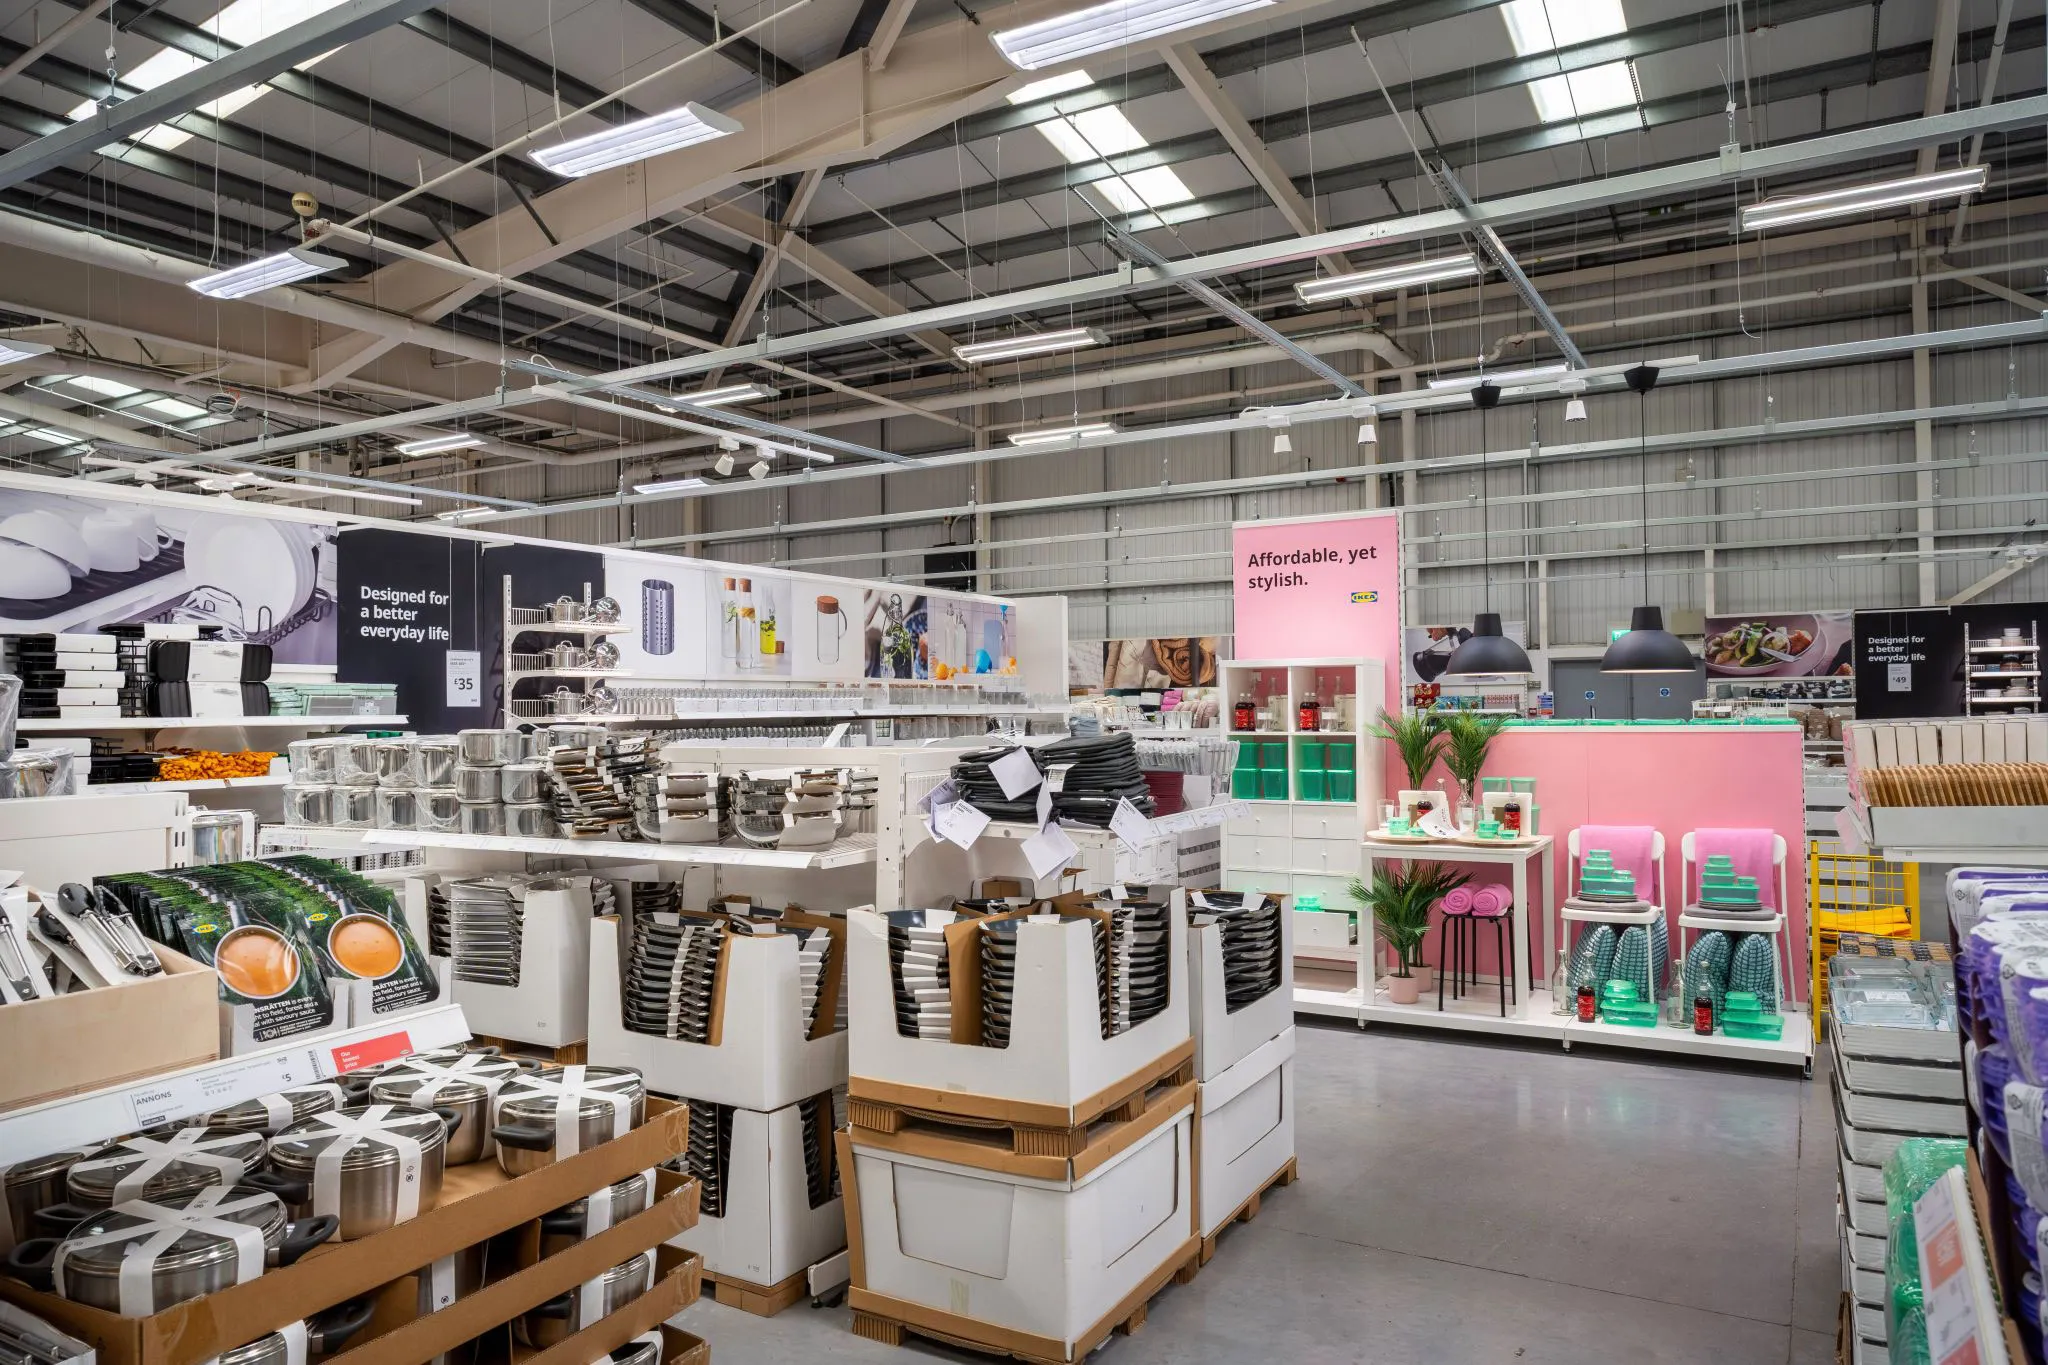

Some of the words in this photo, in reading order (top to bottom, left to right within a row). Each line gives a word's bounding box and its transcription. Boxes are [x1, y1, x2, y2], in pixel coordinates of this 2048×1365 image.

[1248, 548, 1343, 568] Affordable,
[1348, 546, 1377, 565] yet
[1248, 572, 1309, 592] stylish.
[360, 586, 426, 605] Designed
[429, 590, 449, 605] for
[1353, 593, 1376, 602] IKEA
[360, 607, 369, 618] a
[373, 605, 418, 621] better
[360, 625, 425, 643] everyday
[428, 626, 449, 640] life
[1868, 636, 1909, 645] Designed
[1911, 635, 1925, 643] for
[1876, 645, 1904, 653] better
[1868, 654, 1909, 663] everyday
[1911, 653, 1926, 661] life
[454, 677, 473, 690] £35
[136, 1091, 172, 1105] ANNONS
